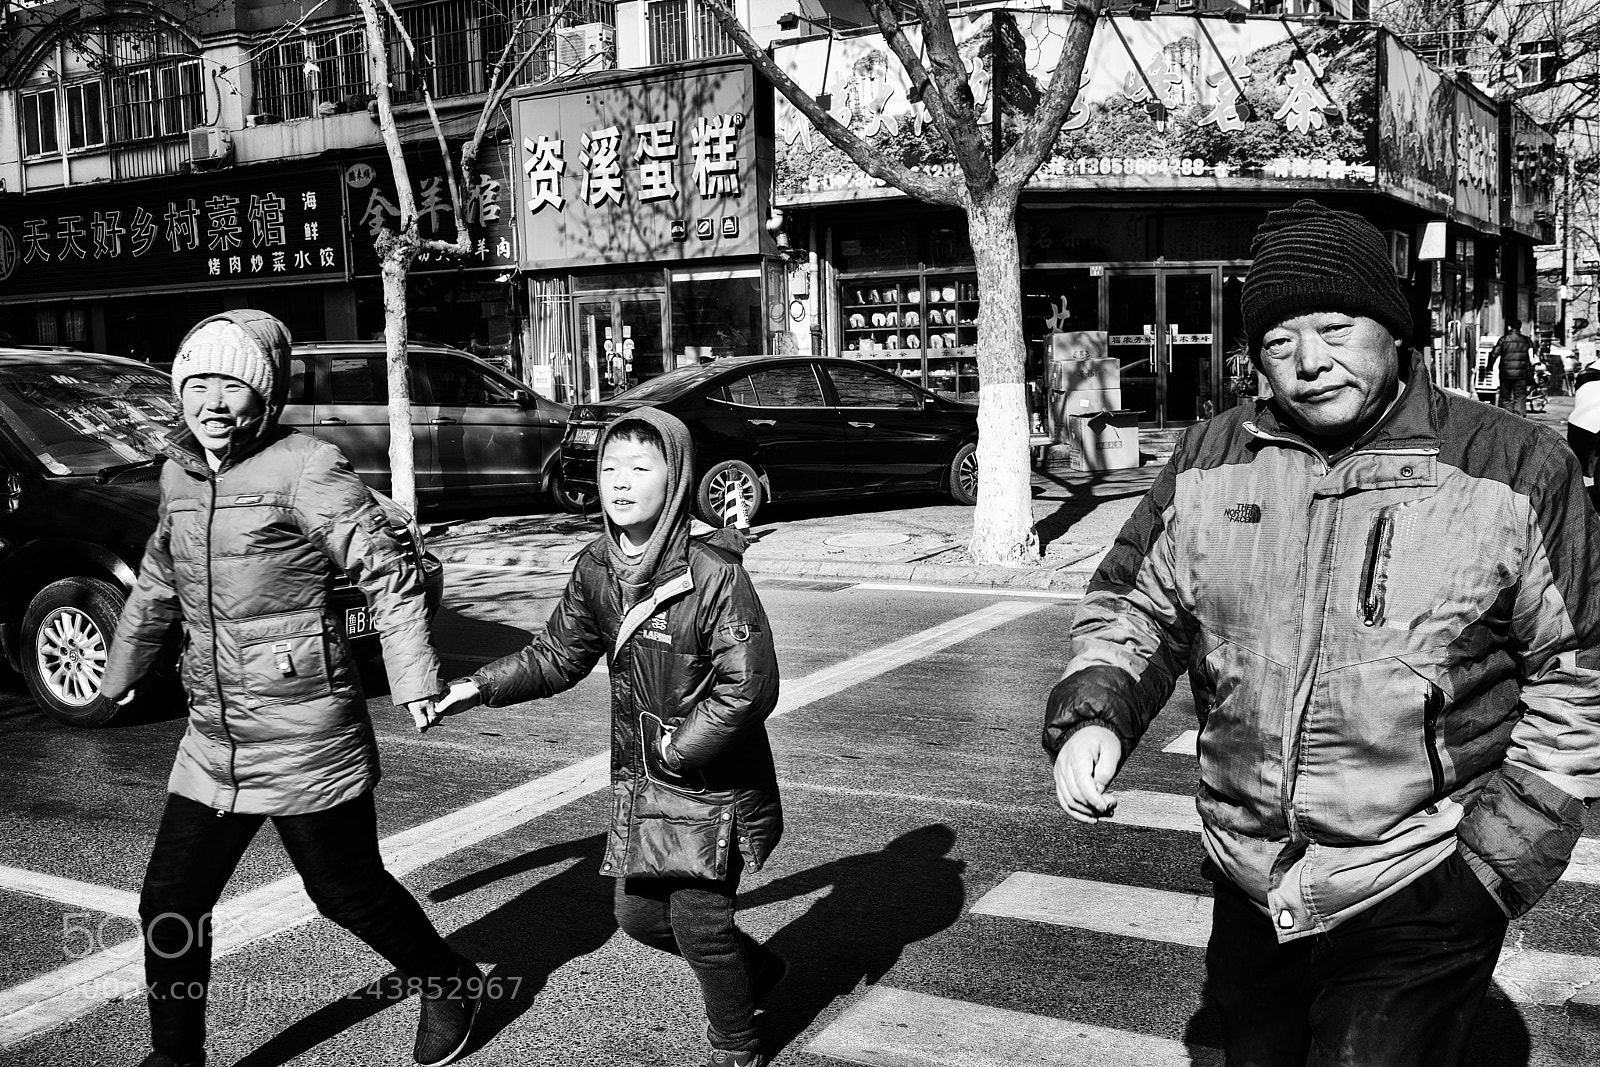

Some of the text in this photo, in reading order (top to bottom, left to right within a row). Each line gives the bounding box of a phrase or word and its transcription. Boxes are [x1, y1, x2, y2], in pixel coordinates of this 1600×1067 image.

[523, 114, 741, 213] 资溪蛋糕
[301, 191, 319, 241] 海鲜
[359, 173, 500, 236] 全羊馆
[22, 191, 286, 265] 天天好乡村菜馆
[208, 246, 336, 276] 烤肉炒菜水饺
[50, 374, 171, 386] MIUBISHI
[1224, 508, 1251, 518] NORTH
[1229, 515, 1252, 523] FACE
[1236, 503, 1253, 511] THE
